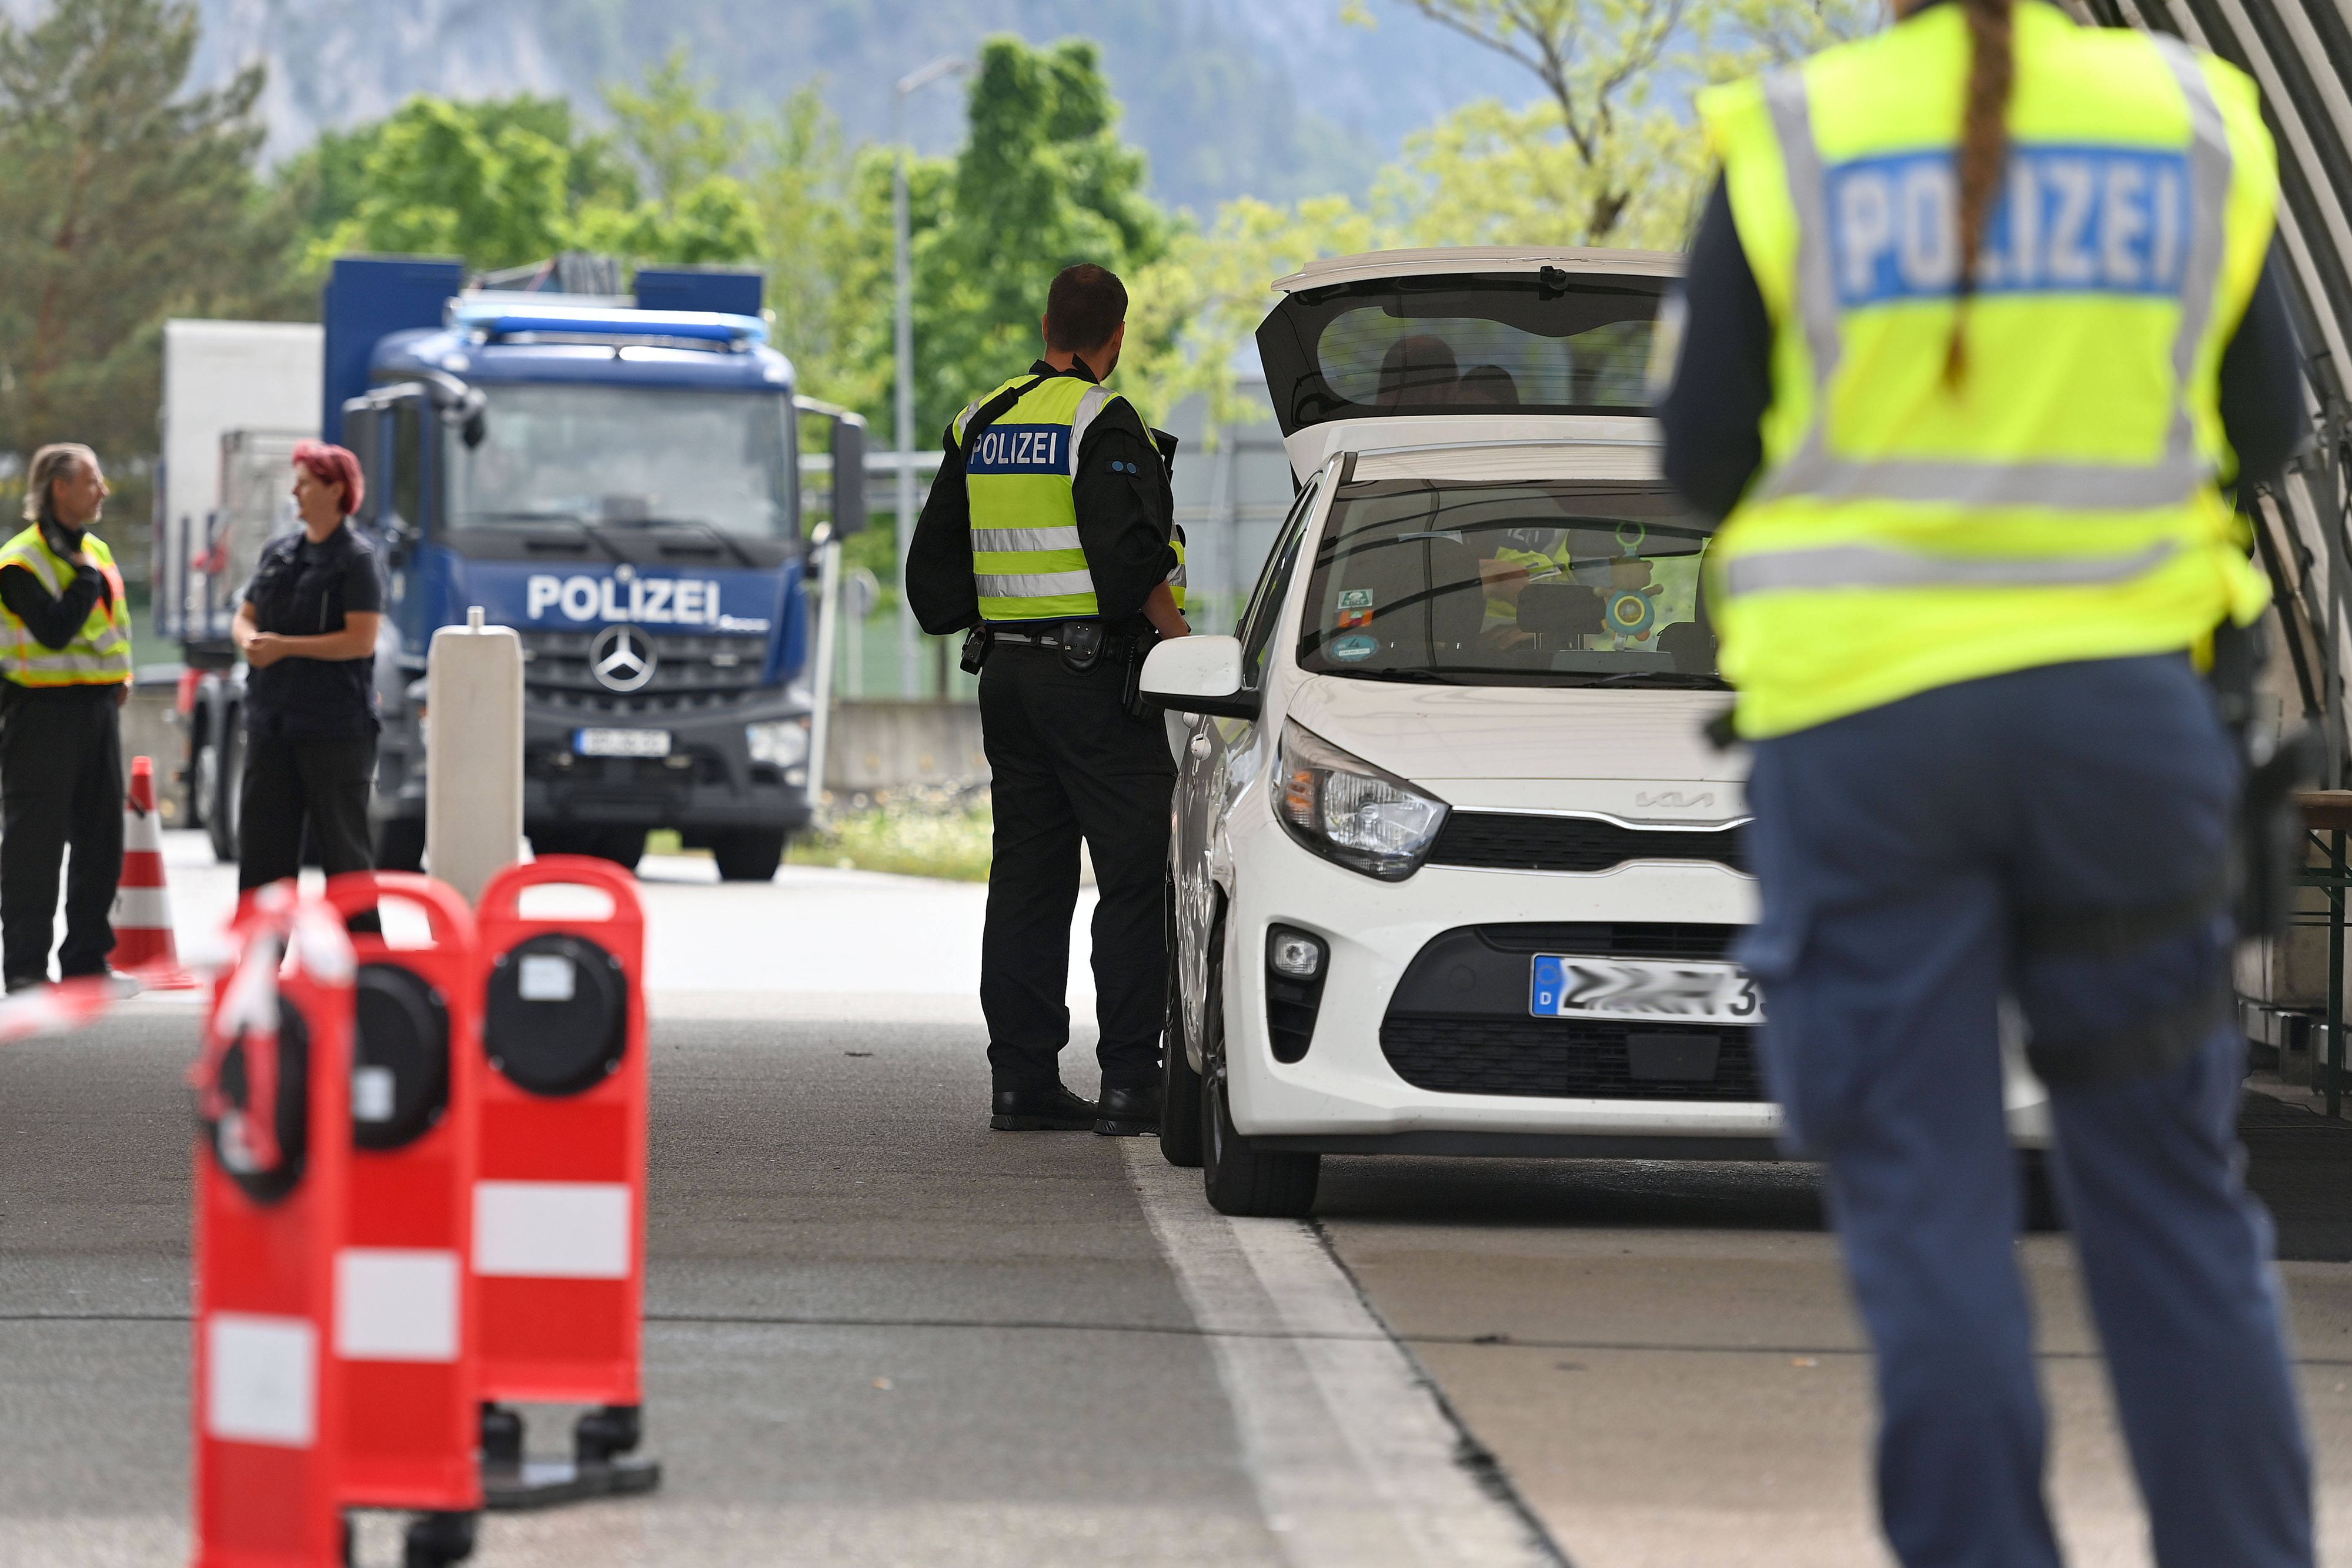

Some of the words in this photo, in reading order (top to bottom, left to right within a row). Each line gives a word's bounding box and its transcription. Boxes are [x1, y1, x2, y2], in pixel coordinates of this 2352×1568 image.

[970, 432, 1057, 464] POLIZEI
[528, 574, 721, 624] POLIZEI
[1636, 792, 1714, 807] KIA
[1539, 992, 1552, 1005] D
